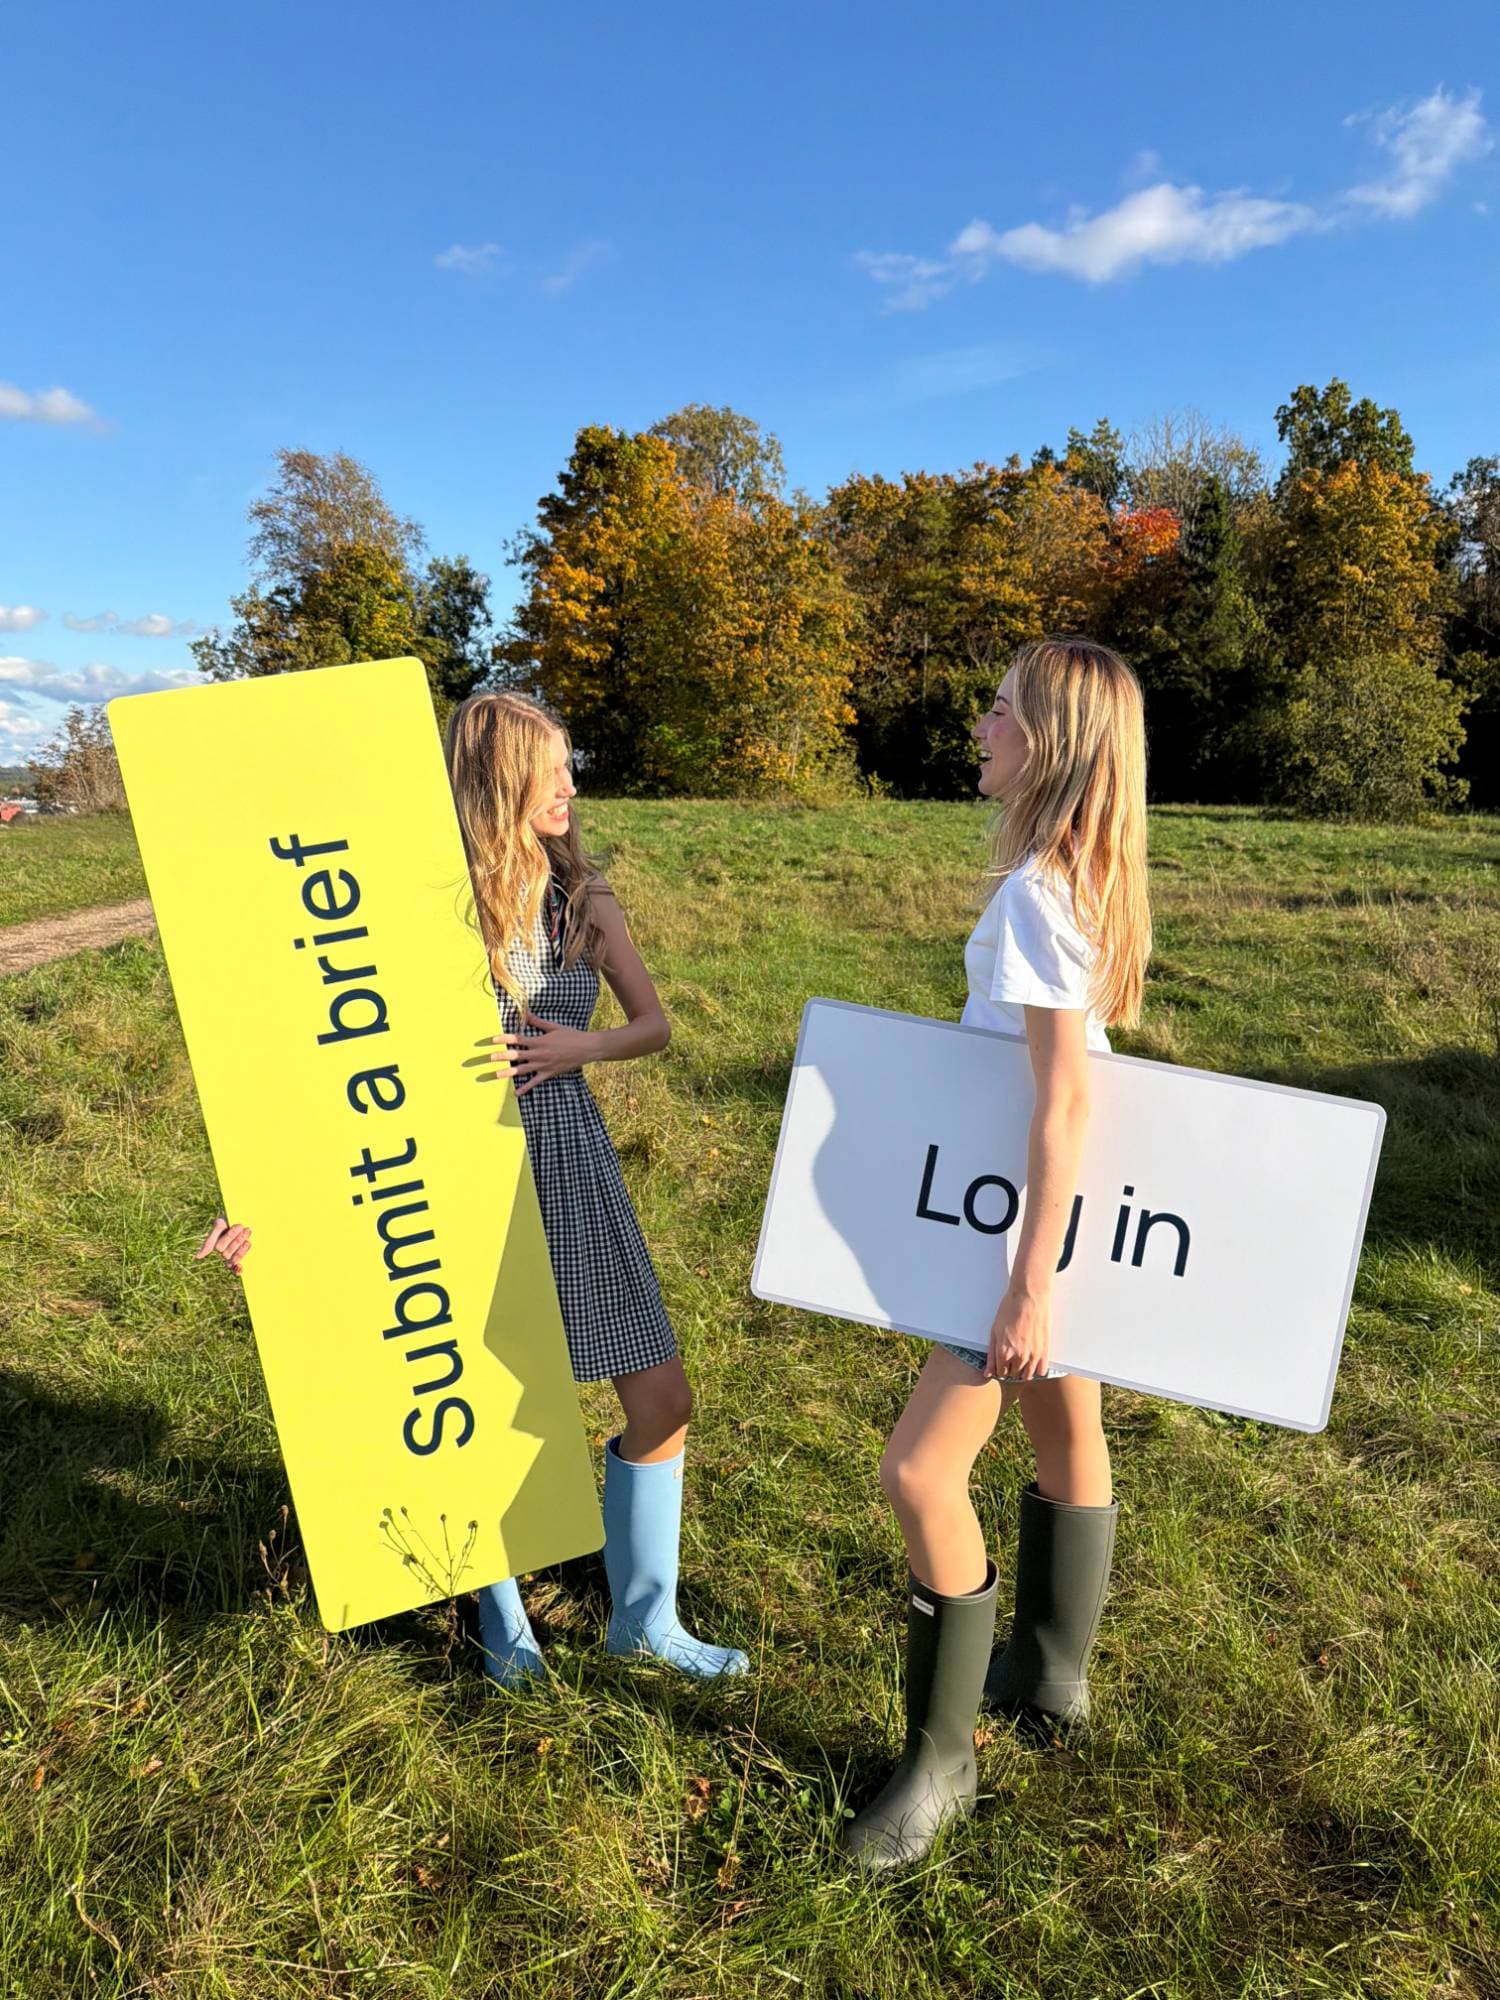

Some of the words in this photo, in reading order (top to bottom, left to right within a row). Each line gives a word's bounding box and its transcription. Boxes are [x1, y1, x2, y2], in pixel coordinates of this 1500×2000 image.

[268, 834, 390, 1045] brief
[347, 1064, 406, 1114] a
[351, 1137, 475, 1456] Submit
[1110, 1185, 1190, 1277] in
